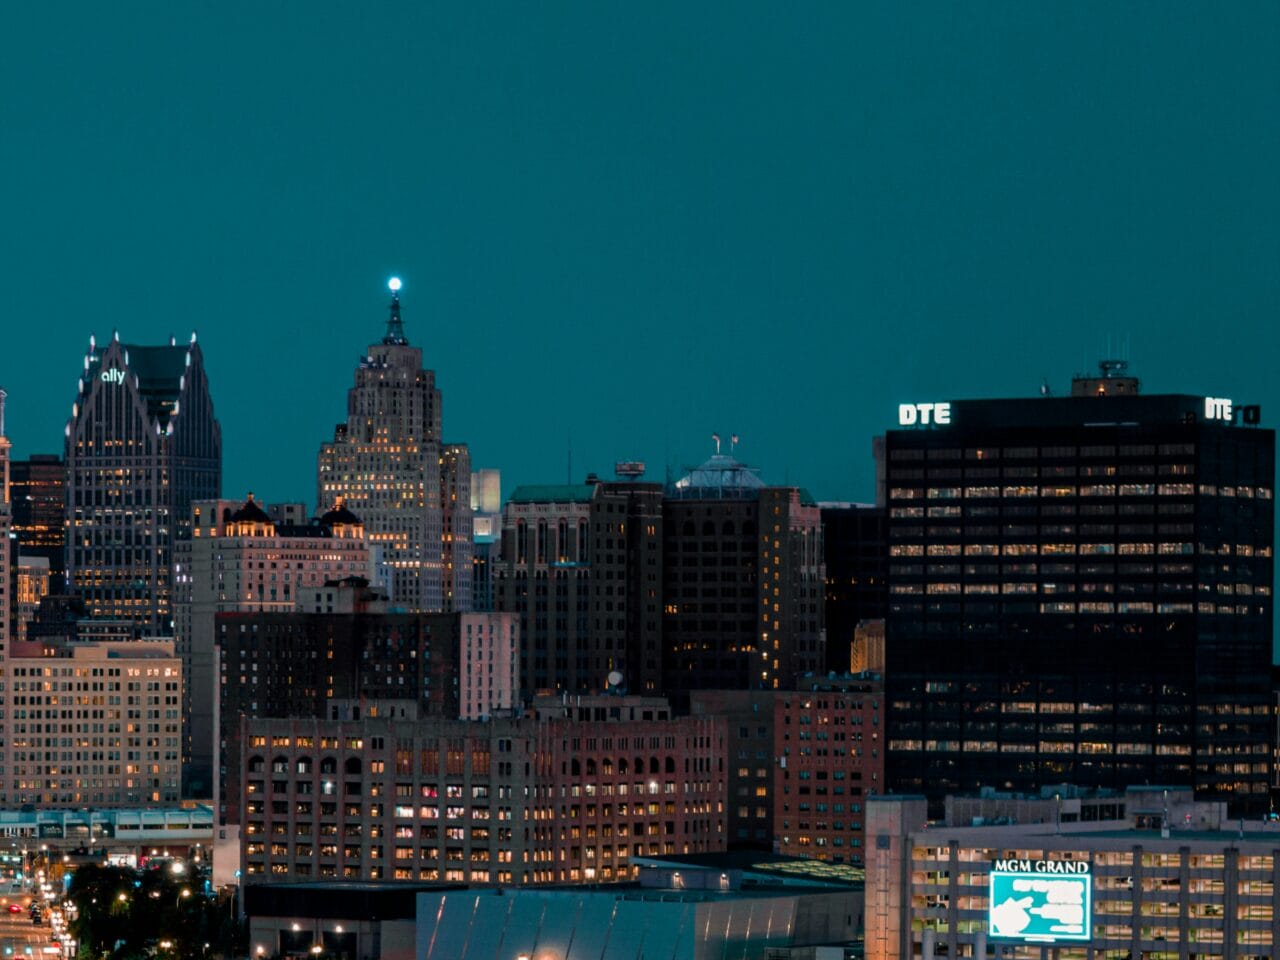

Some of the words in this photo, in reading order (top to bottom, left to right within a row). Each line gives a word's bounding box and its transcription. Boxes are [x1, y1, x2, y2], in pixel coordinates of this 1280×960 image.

[101, 368, 126, 385] ally
[898, 402, 951, 425] DTE
[1204, 396, 1233, 421] DTE
[995, 860, 1032, 873] MGM
[1035, 860, 1089, 874] GRAND
